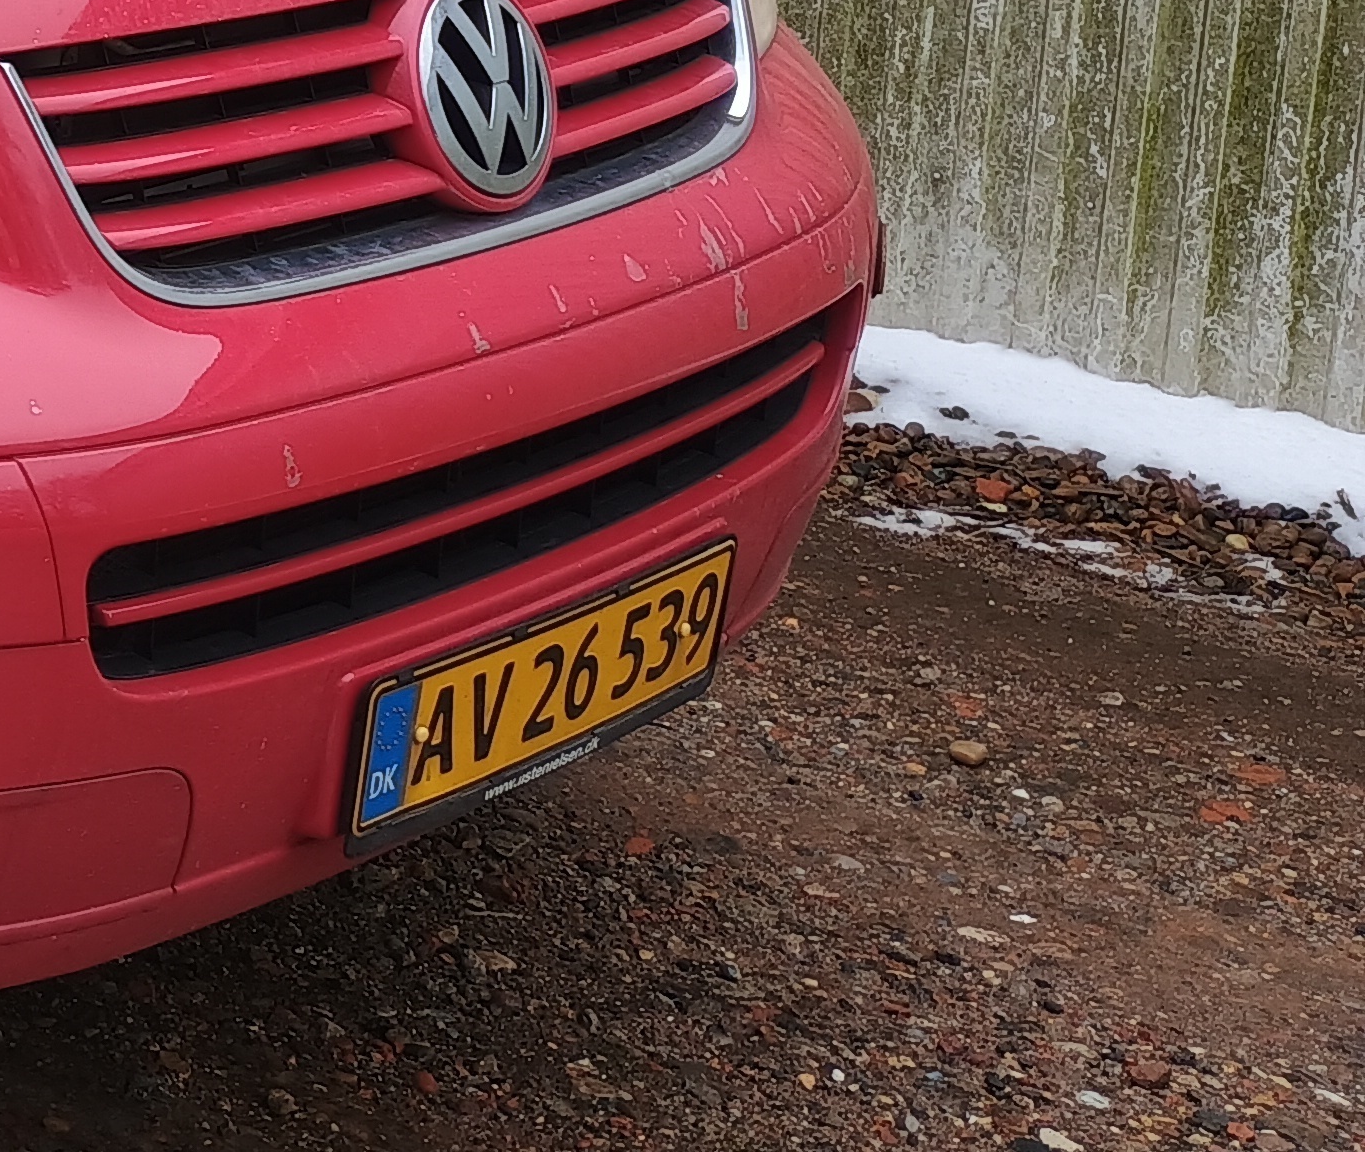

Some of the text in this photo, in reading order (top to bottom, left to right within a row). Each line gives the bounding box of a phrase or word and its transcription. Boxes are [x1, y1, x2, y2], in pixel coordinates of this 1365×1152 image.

[410, 571, 720, 787] AV 26 539
[368, 763, 399, 801] DK
